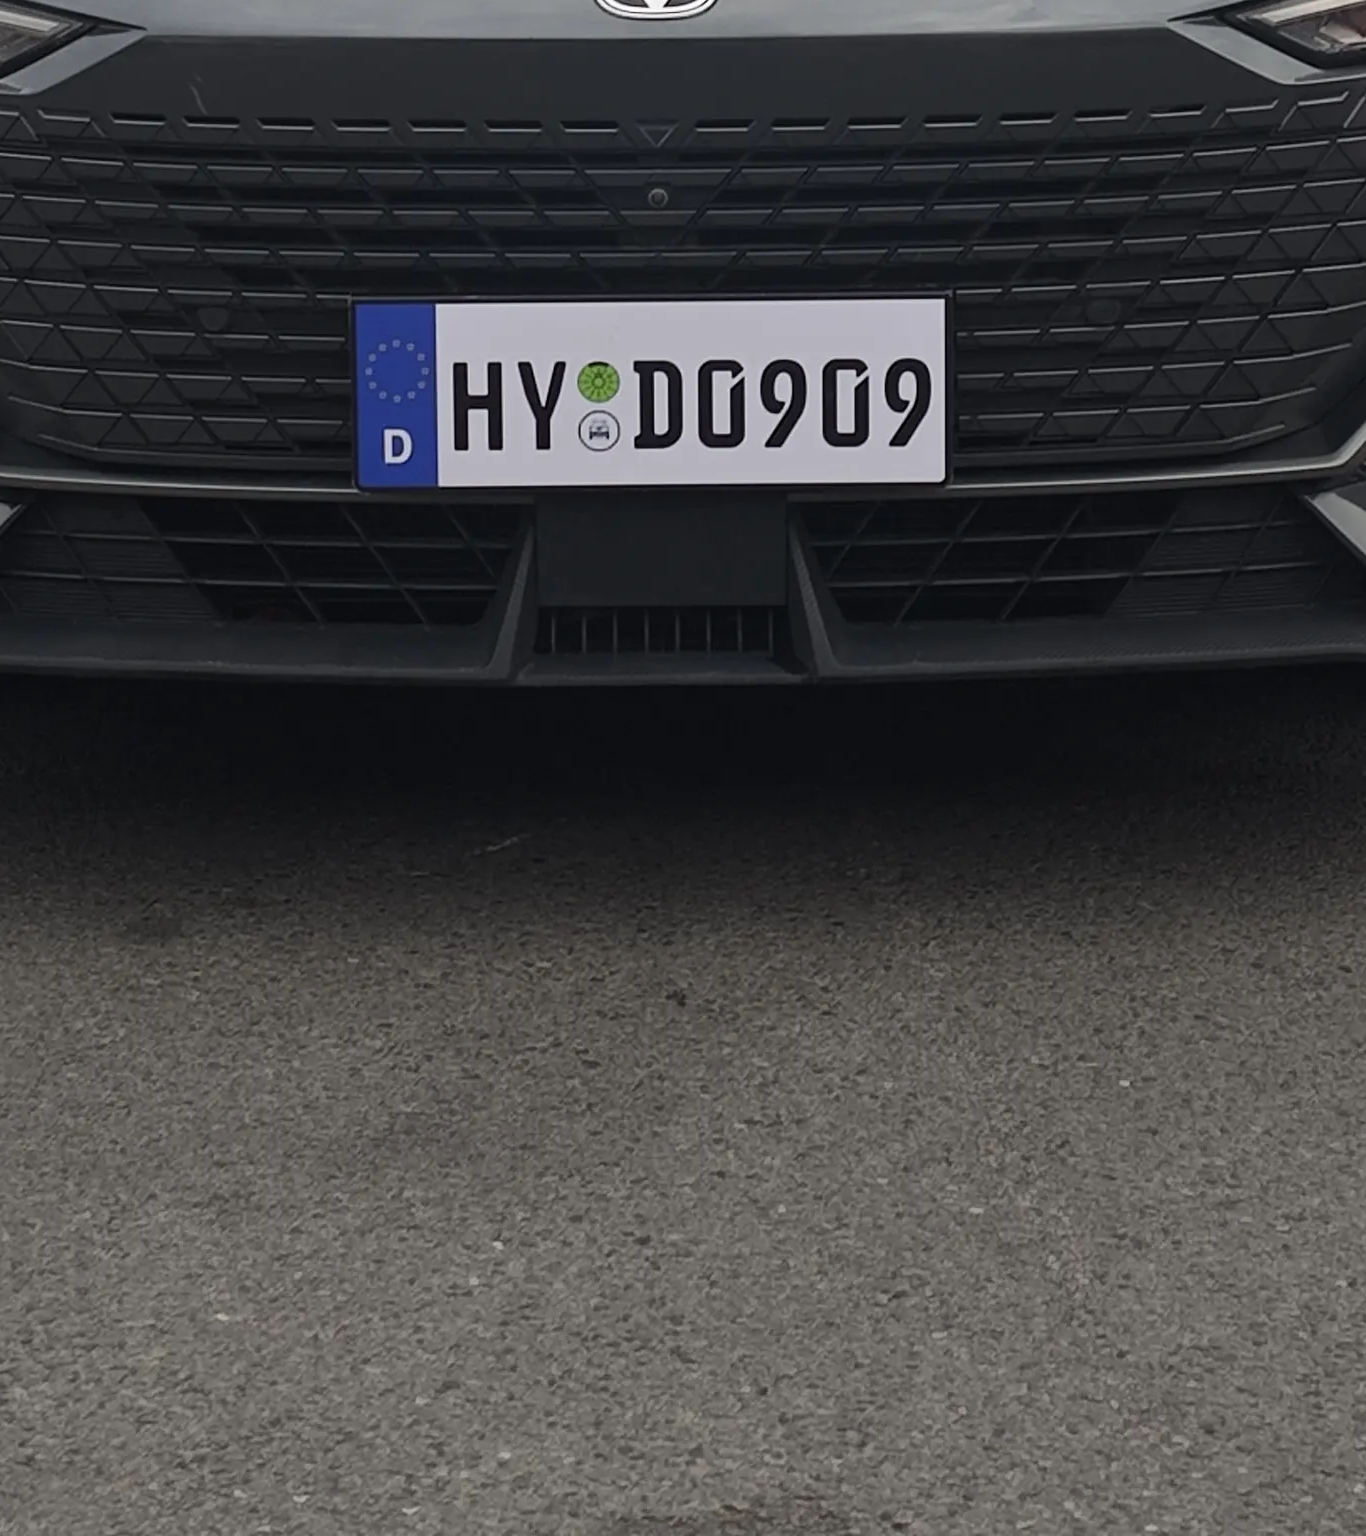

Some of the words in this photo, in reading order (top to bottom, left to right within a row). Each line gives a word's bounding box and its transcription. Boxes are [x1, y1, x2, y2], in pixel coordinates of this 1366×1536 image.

[451, 360, 567, 451] HY
[633, 357, 932, 449] D0909
[382, 428, 413, 465] D
